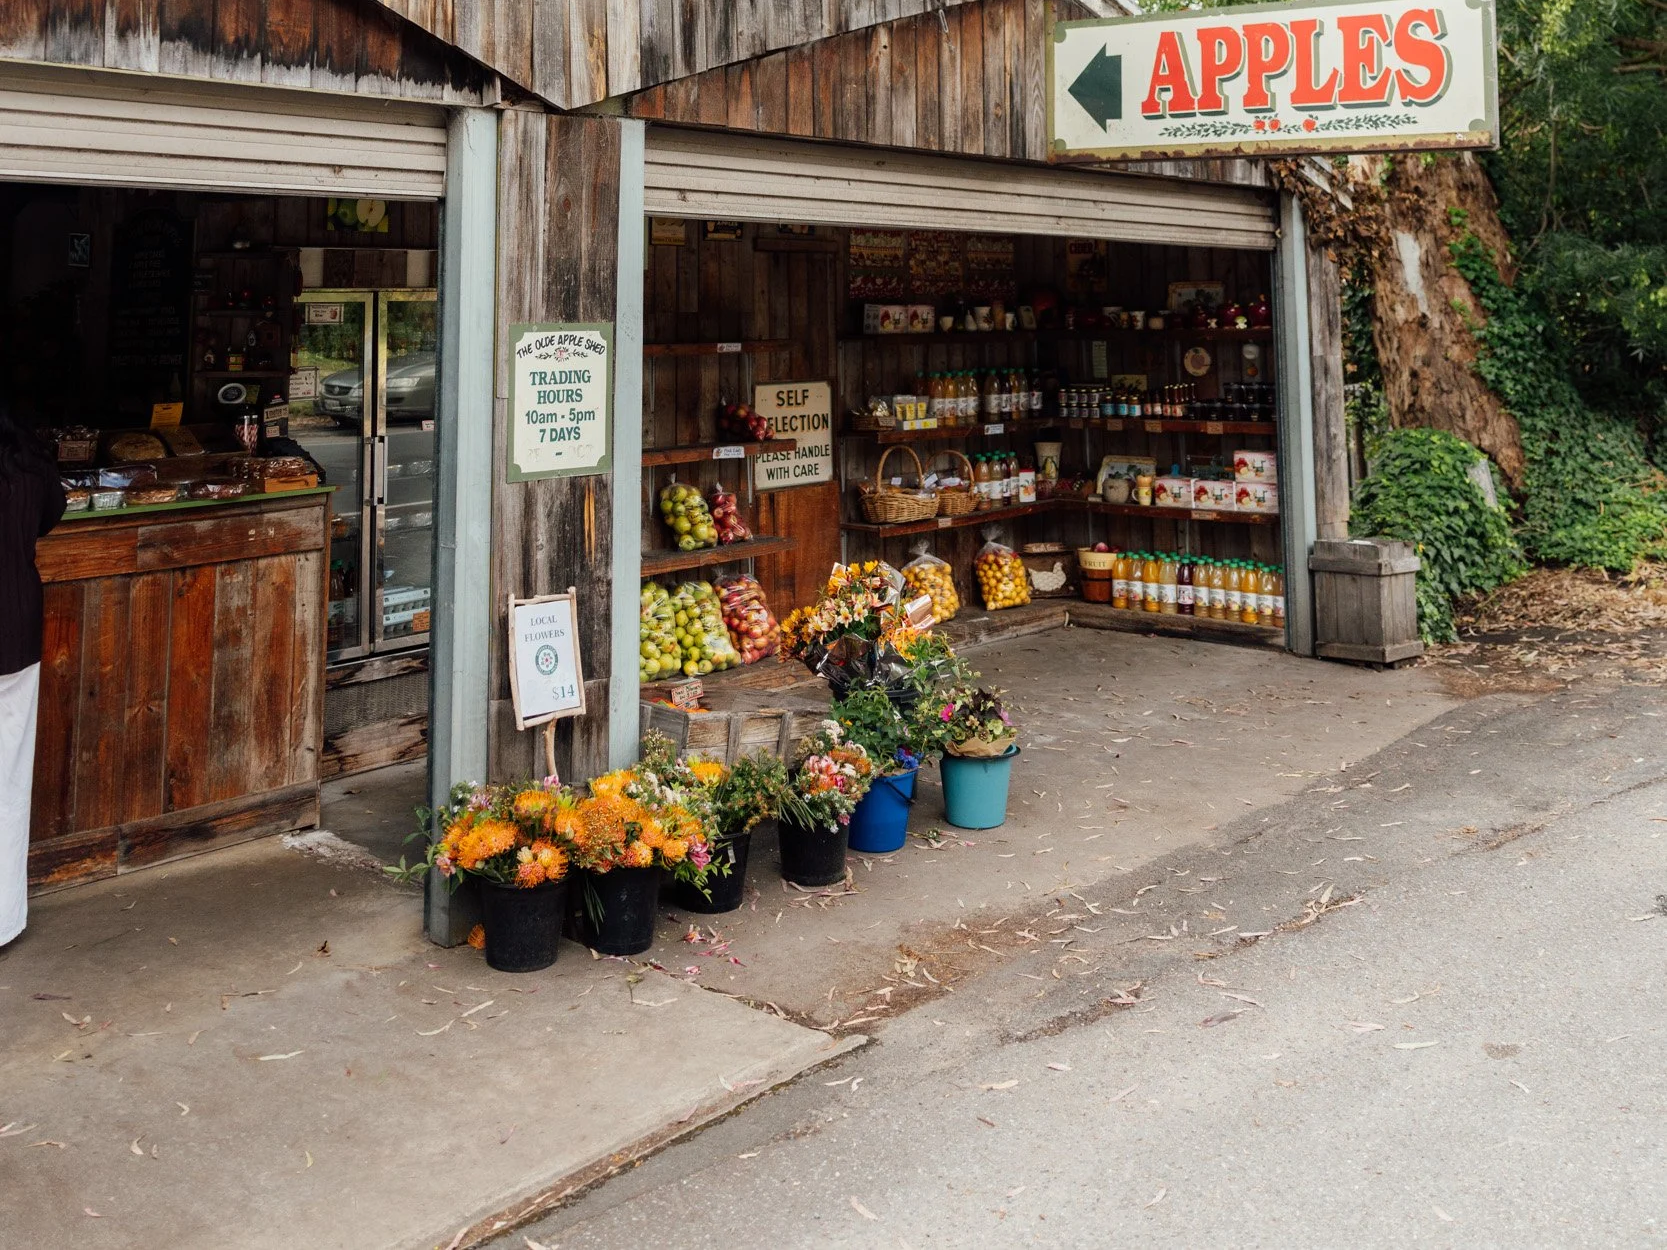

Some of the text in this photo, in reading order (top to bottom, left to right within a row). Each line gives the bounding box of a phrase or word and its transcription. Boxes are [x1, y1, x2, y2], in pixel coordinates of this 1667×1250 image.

[1142, 8, 1453, 119] APPLES
[517, 334, 606, 358] THE OLDE APPLE SHED
[529, 369, 592, 386] TRADING
[537, 388, 583, 404] HOURS
[776, 389, 809, 407] SELF
[525, 410, 558, 425] 10am
[568, 408, 595, 425] 5pm
[766, 413, 829, 433] ELECTION
[539, 426, 581, 443] 7 DAYS
[755, 444, 830, 464] PLEASE HANDLE
[766, 463, 819, 481] WITH CARE
[1084, 560, 1106, 568] FRUIT
[530, 615, 557, 626] LOCAL
[524, 628, 565, 643] FLOWERS
[552, 684, 575, 700] $14
